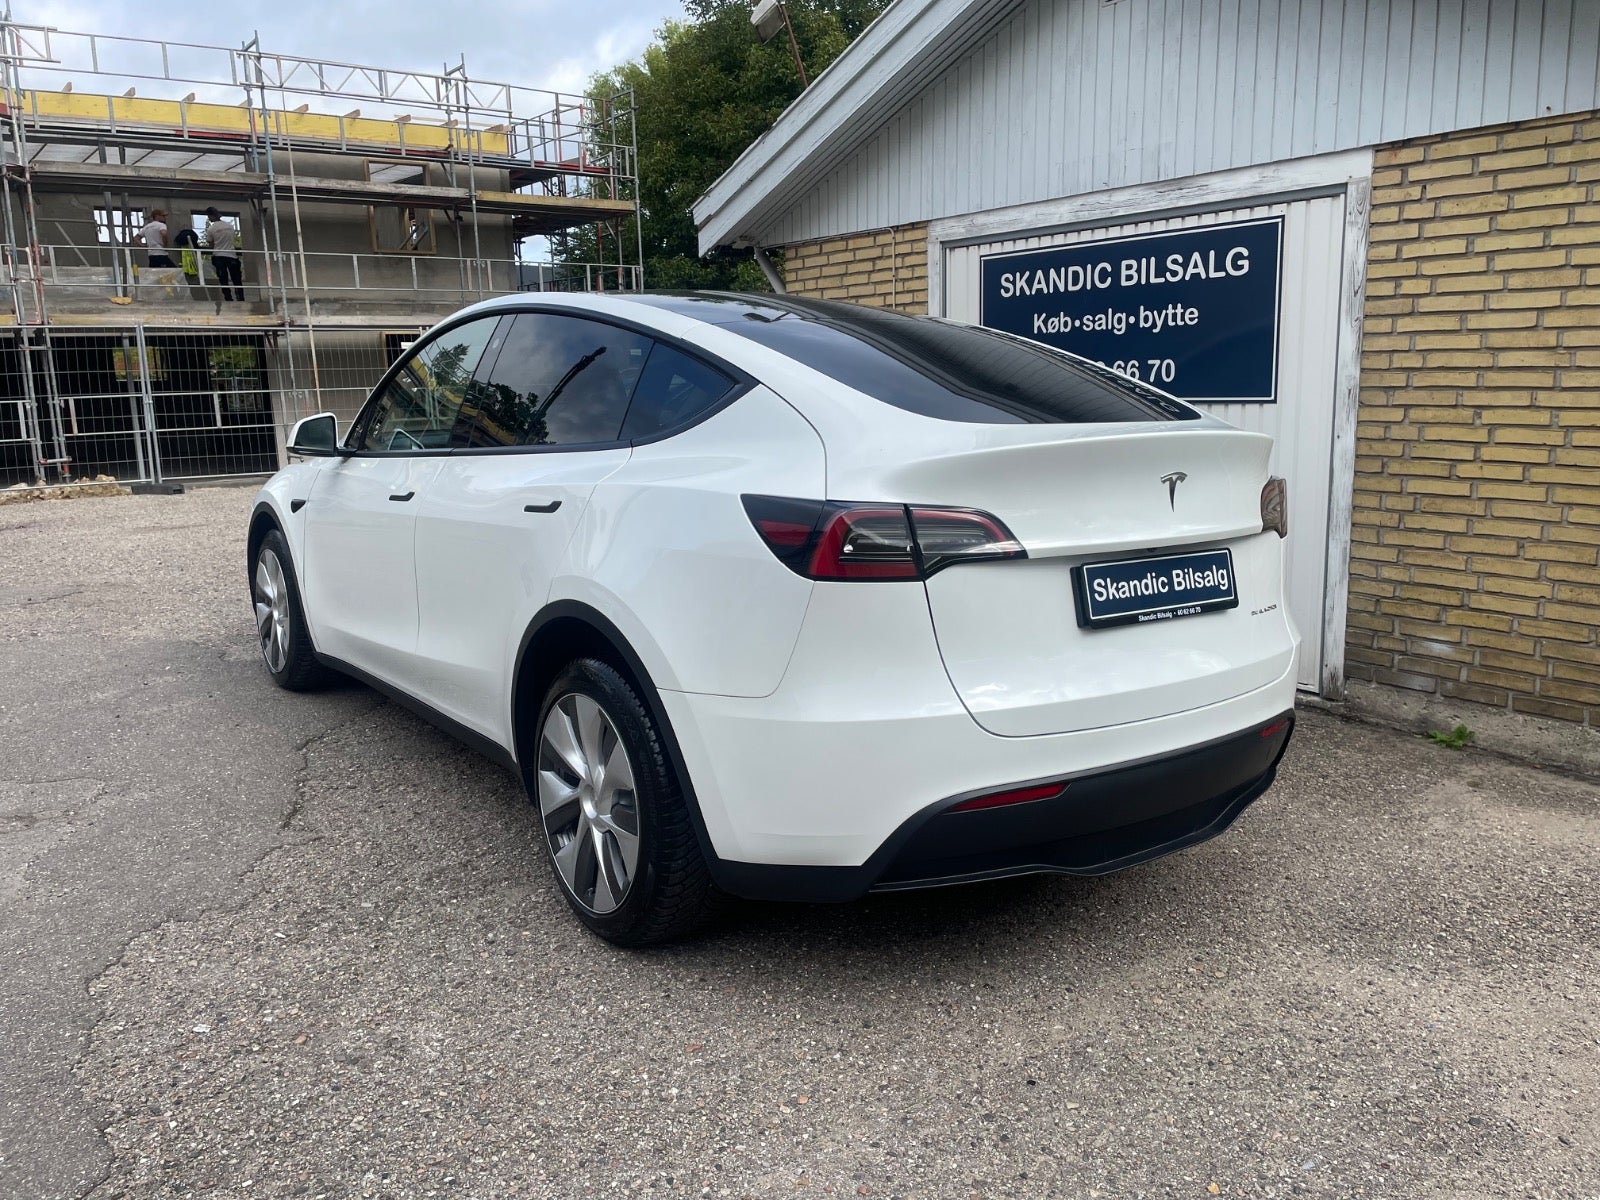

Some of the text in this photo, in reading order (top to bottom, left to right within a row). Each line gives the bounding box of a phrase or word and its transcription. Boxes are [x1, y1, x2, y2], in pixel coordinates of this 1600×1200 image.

[1000, 247, 1250, 298] SKANDIC BILSALG
[1147, 358, 1176, 383] 70
[1093, 564, 1228, 602] Skandic Bilsalg
[1138, 613, 1157, 621] Skandic
[1157, 611, 1173, 619] Bilsalg
